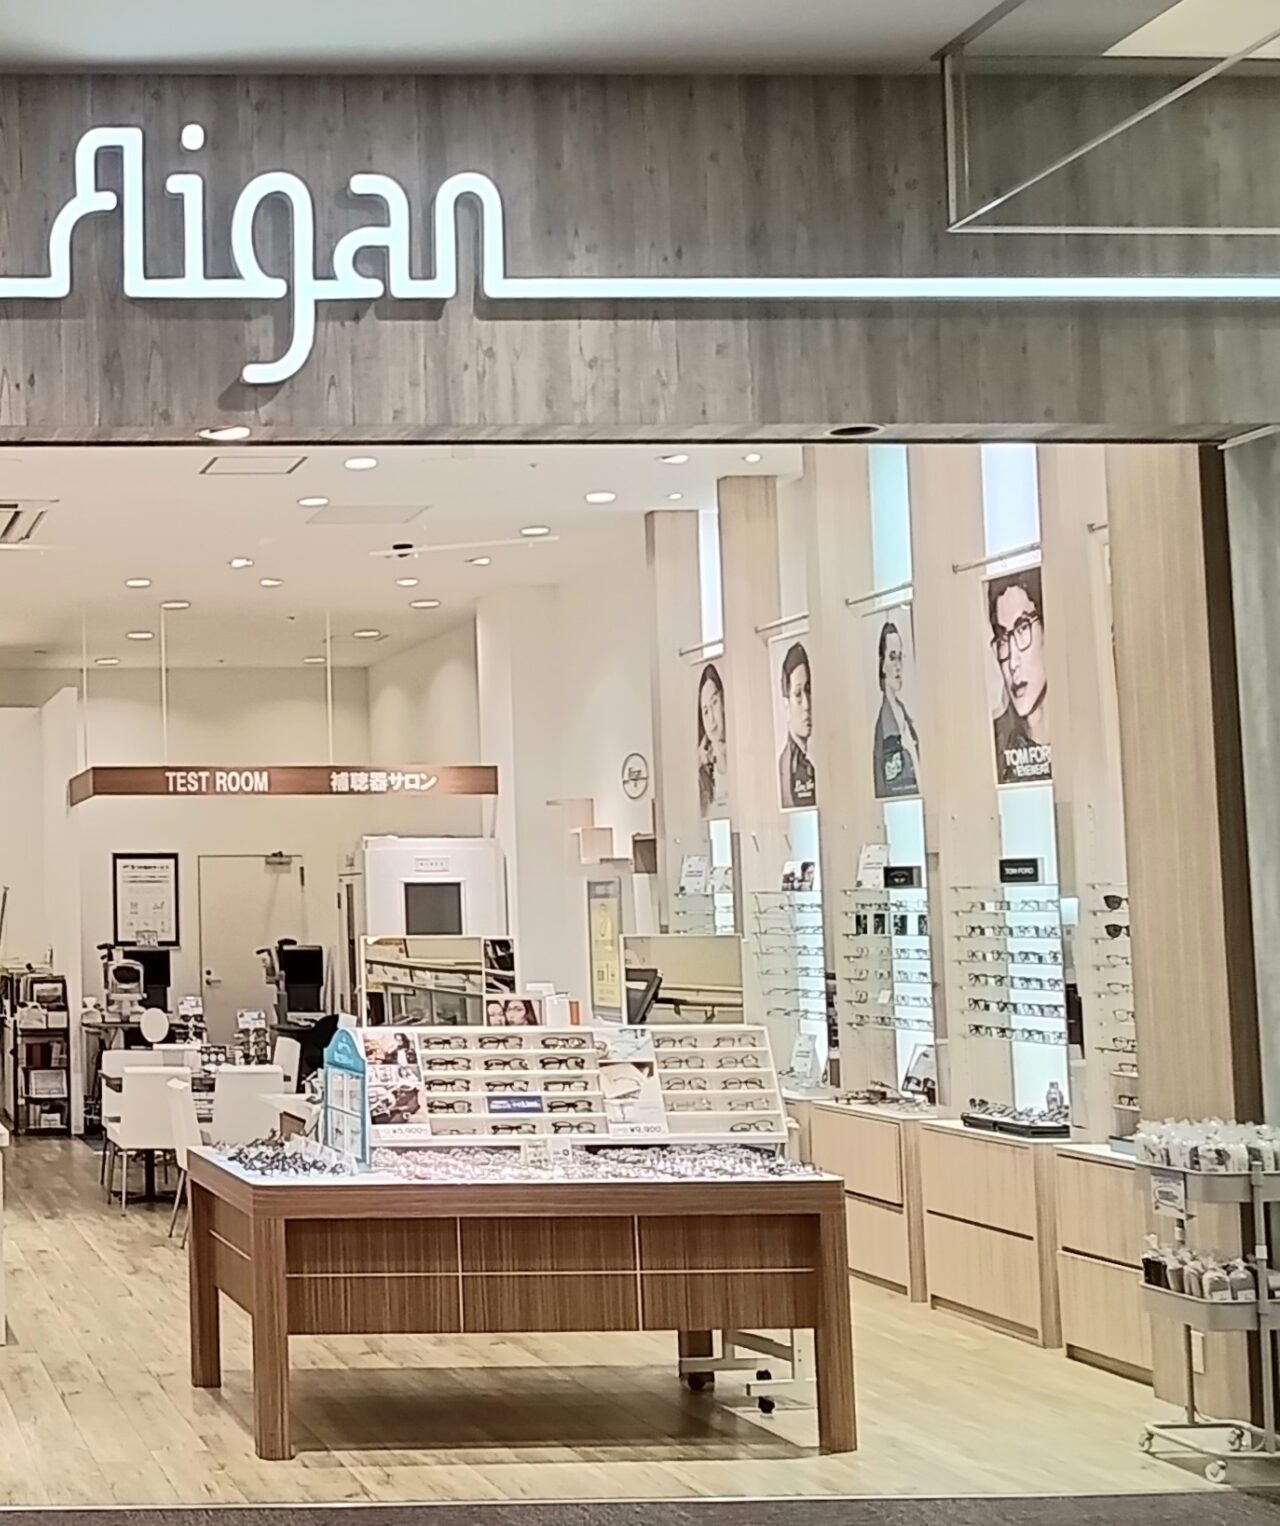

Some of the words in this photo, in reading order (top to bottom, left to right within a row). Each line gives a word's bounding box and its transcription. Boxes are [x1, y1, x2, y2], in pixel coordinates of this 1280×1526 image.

[49, 123, 505, 384] Aigan
[1004, 748, 1029, 767] TOM
[1029, 745, 1052, 764] FOR
[165, 771, 210, 792] TEST
[215, 771, 269, 792] ROOM
[330, 771, 439, 792] 補聴器サロン
